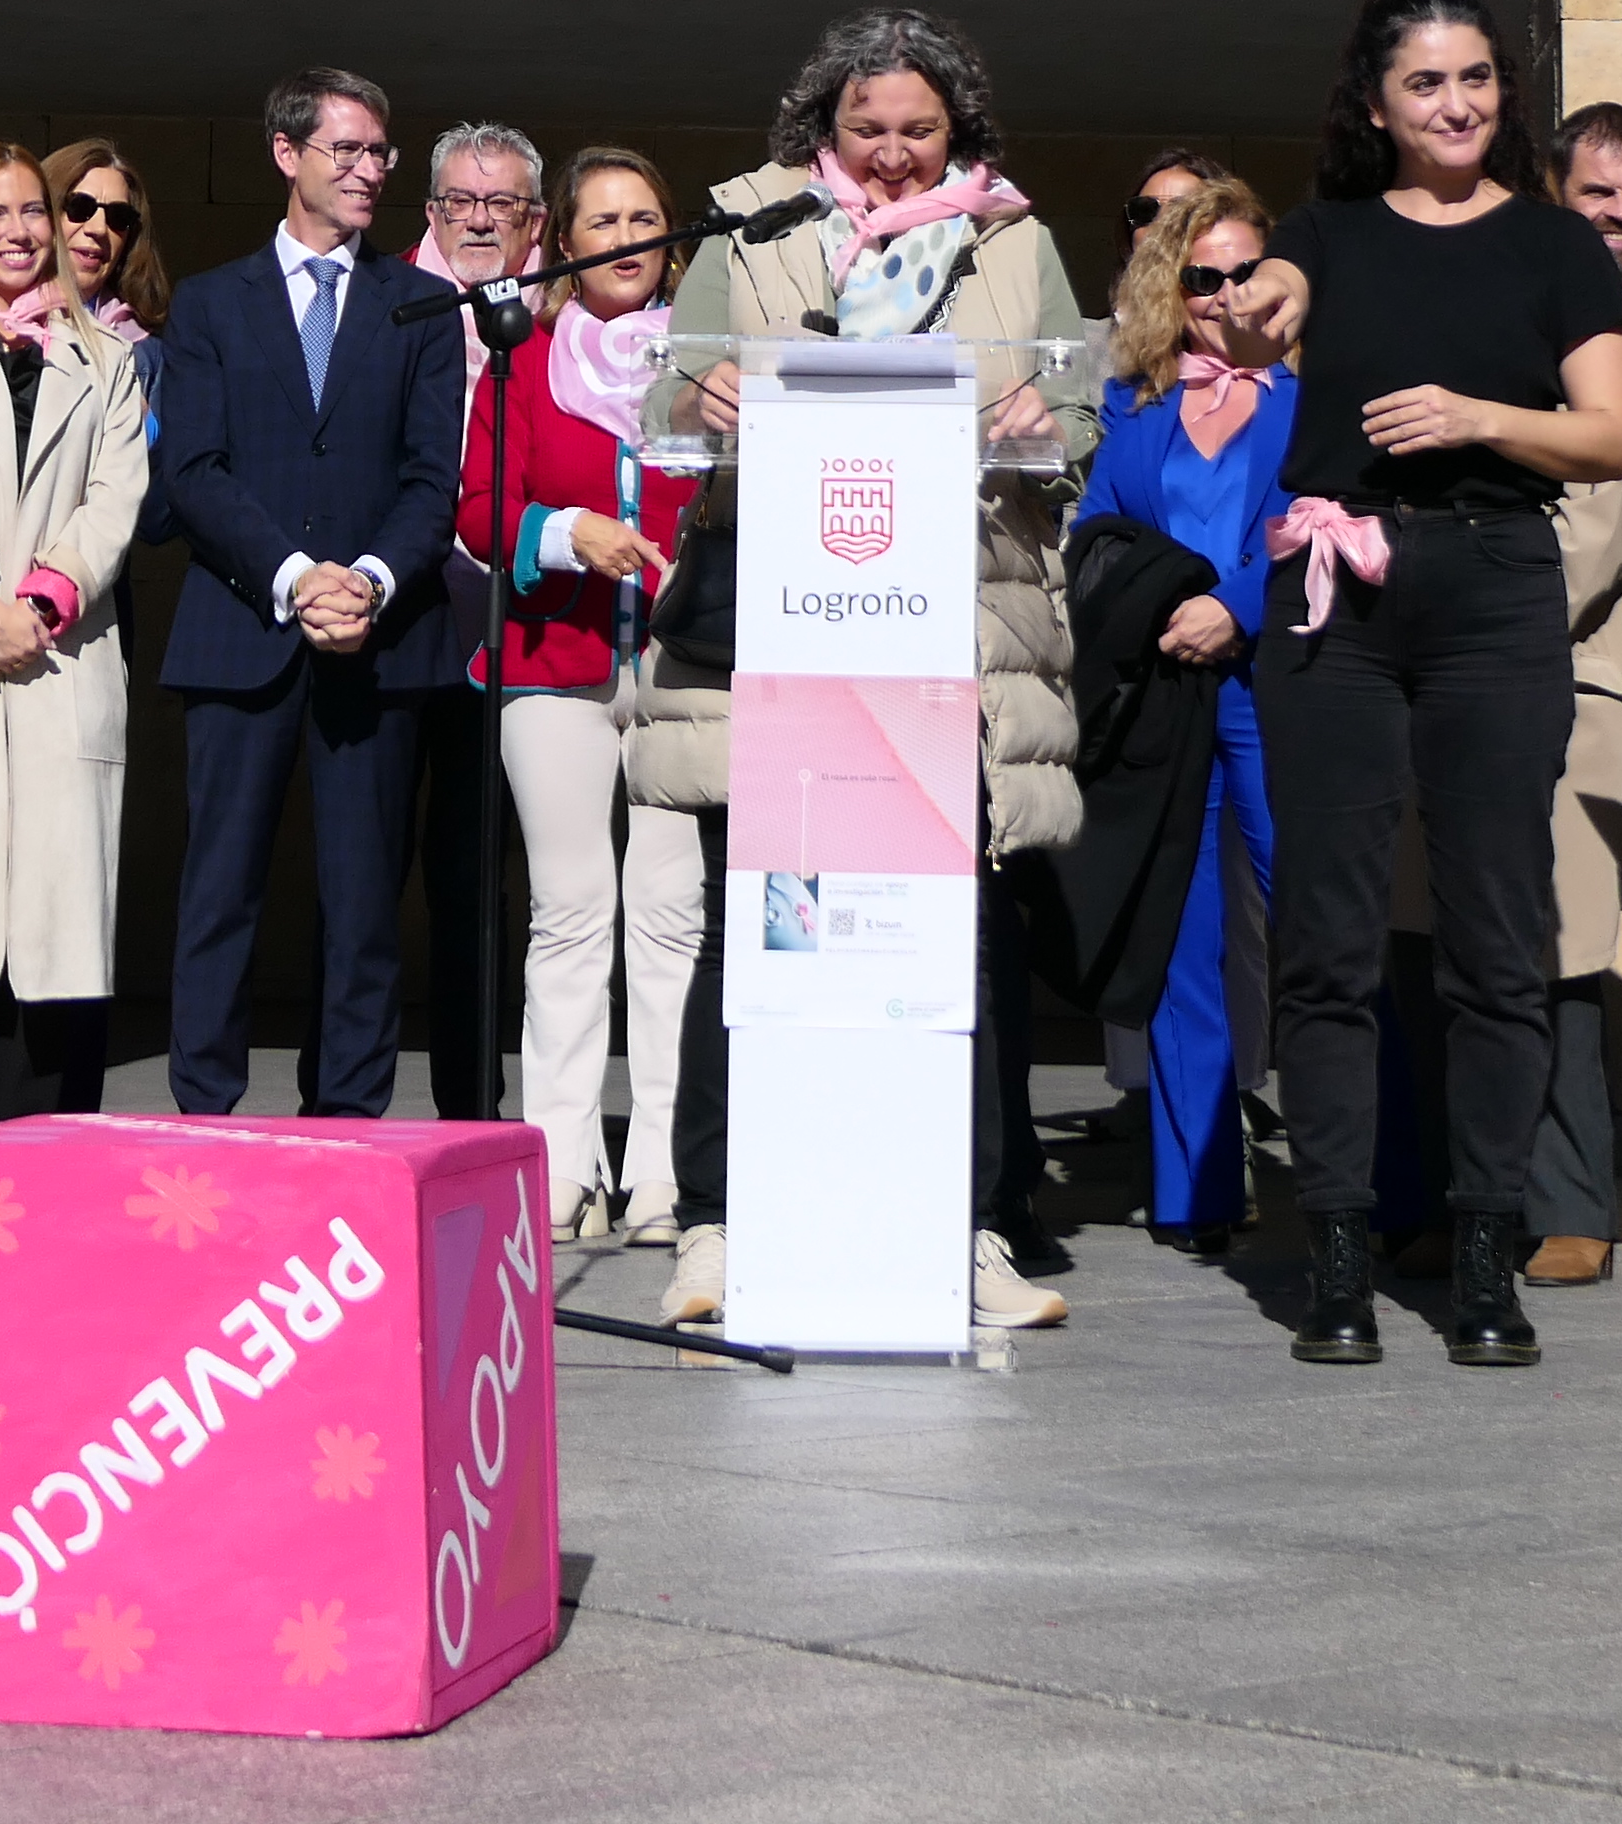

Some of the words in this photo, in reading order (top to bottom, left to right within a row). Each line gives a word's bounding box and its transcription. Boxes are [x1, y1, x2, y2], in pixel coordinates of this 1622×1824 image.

[782, 585, 929, 623] Logroño
[875, 919, 902, 928] bizum
[435, 1168, 538, 1669] APOYO
